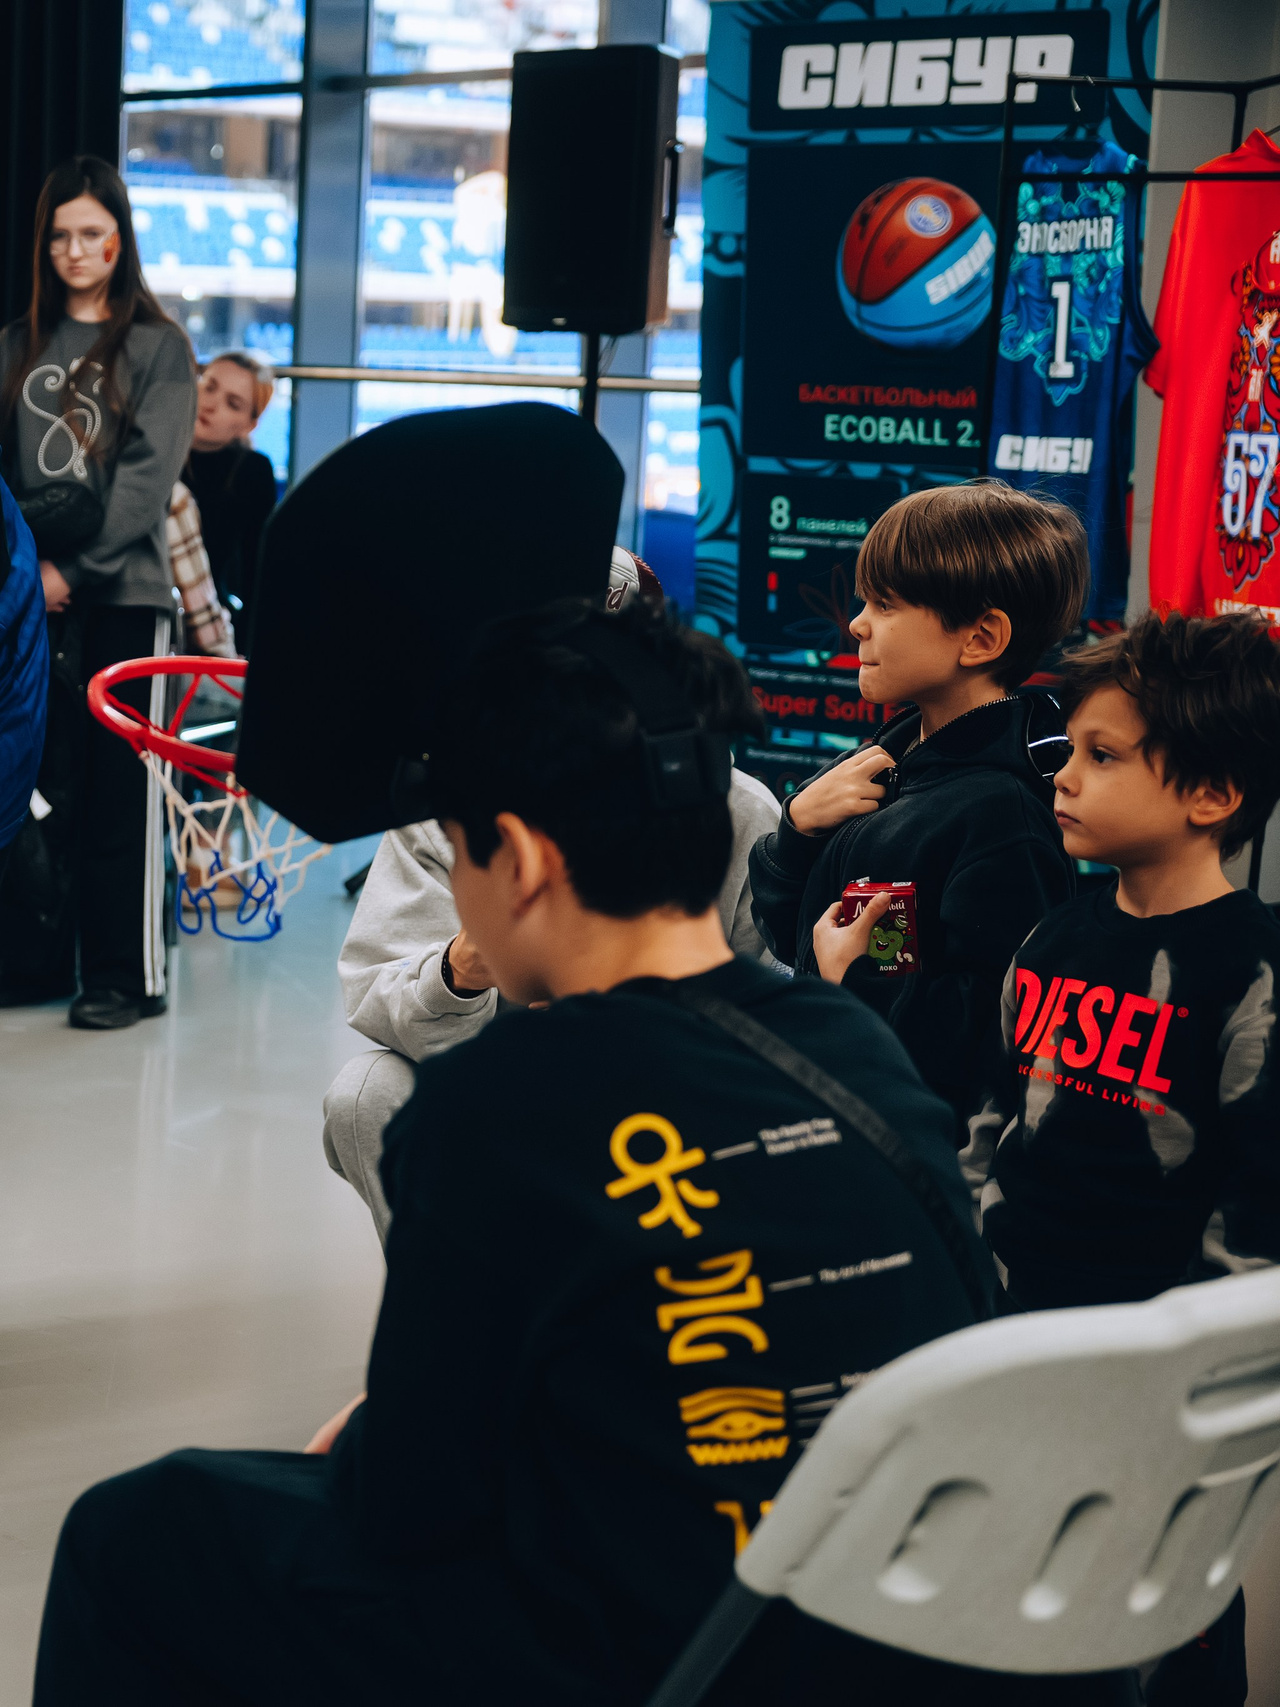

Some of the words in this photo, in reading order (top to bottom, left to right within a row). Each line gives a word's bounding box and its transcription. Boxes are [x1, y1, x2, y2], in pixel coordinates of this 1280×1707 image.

[777, 34, 1075, 111] СИБУР
[1049, 281, 1074, 379] 1
[798, 383, 978, 409] БАСКЕТБОЛЬНЫЙ
[824, 413, 950, 447] ECOBALL
[955, 419, 981, 448] 2.
[994, 434, 1094, 474] СИБУ
[769, 496, 791, 531] 8
[752, 686, 818, 719] Super
[824, 694, 876, 723] Soft
[1014, 967, 1173, 1094] DIESEL
[1018, 1063, 1095, 1096] UCCESSFUL
[1101, 1088, 1166, 1116] LIVING
